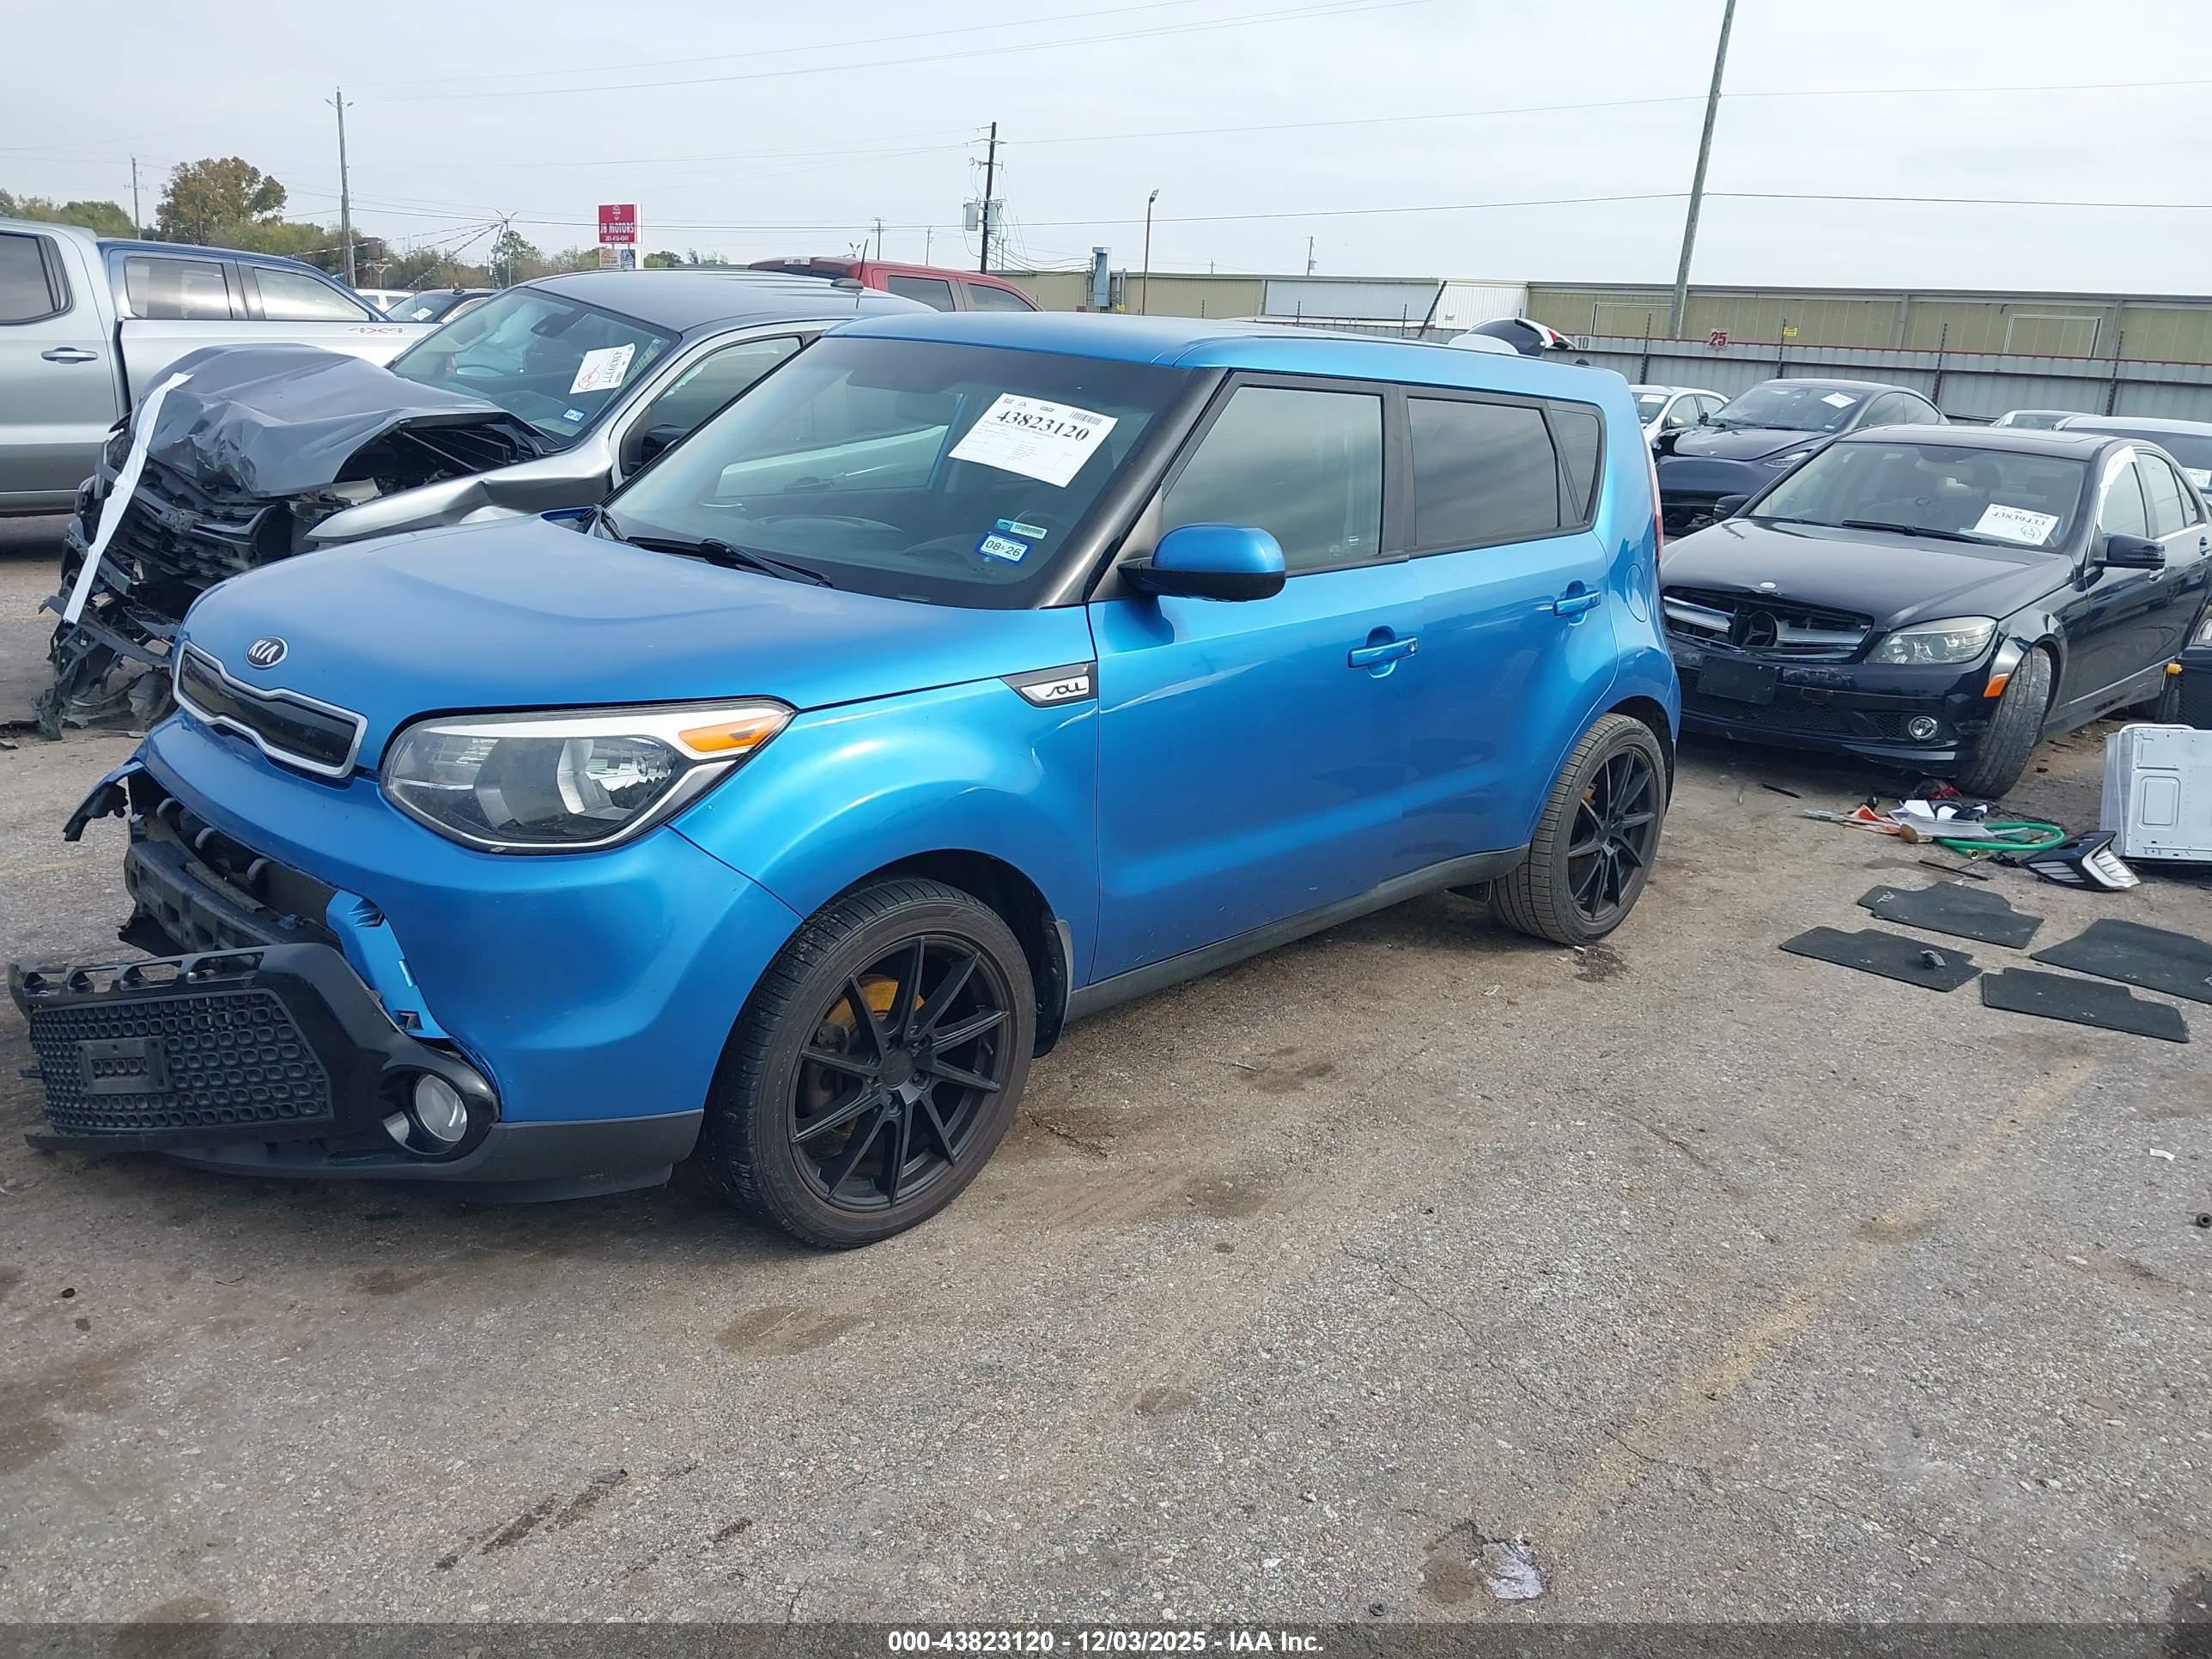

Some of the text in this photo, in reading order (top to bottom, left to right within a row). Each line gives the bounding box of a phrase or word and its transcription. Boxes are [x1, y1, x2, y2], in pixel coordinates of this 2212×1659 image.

[600, 222, 635, 234] JB MOTORS
[1577, 336, 1589, 349] 10
[1709, 331, 1728, 346] 25
[996, 410, 1090, 441] 43823120
[247, 639, 280, 663] KIA
